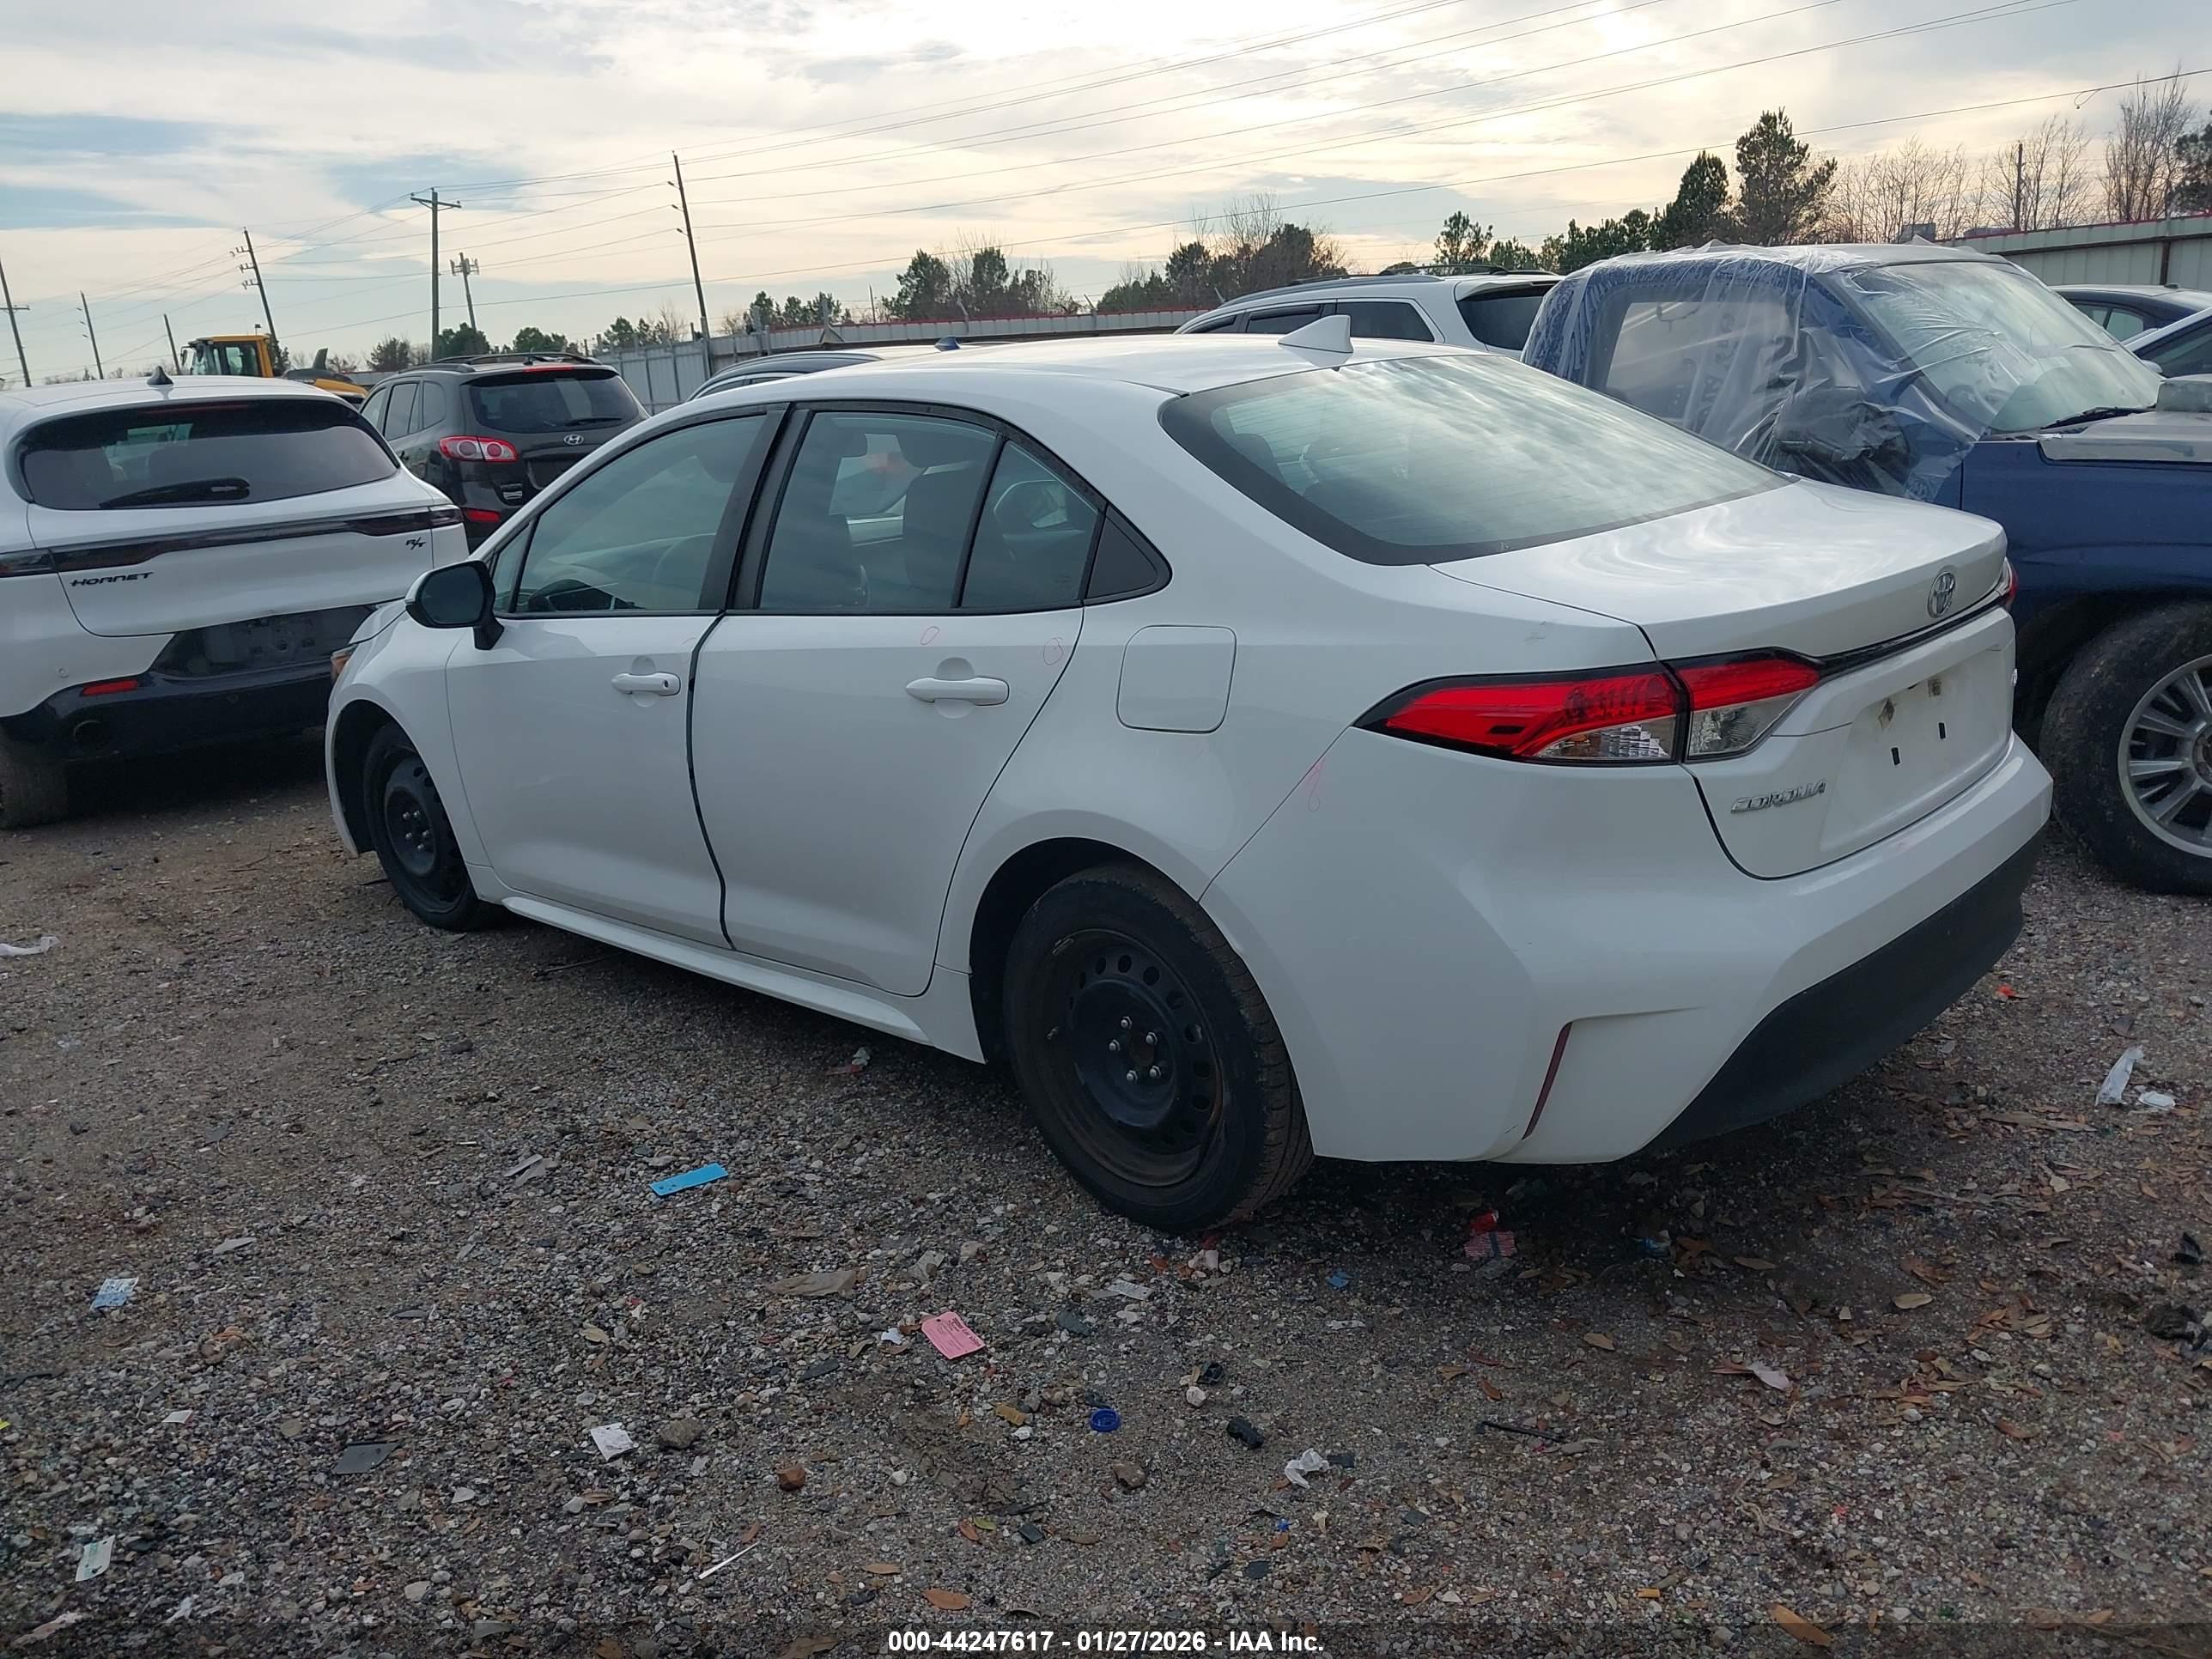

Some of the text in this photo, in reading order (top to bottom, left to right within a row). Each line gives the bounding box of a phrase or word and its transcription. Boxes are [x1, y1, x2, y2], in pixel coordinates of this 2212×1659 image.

[405, 536, 427, 550] R/T
[70, 572, 154, 586] HORNET
[1730, 781, 1826, 813] COROLLA
